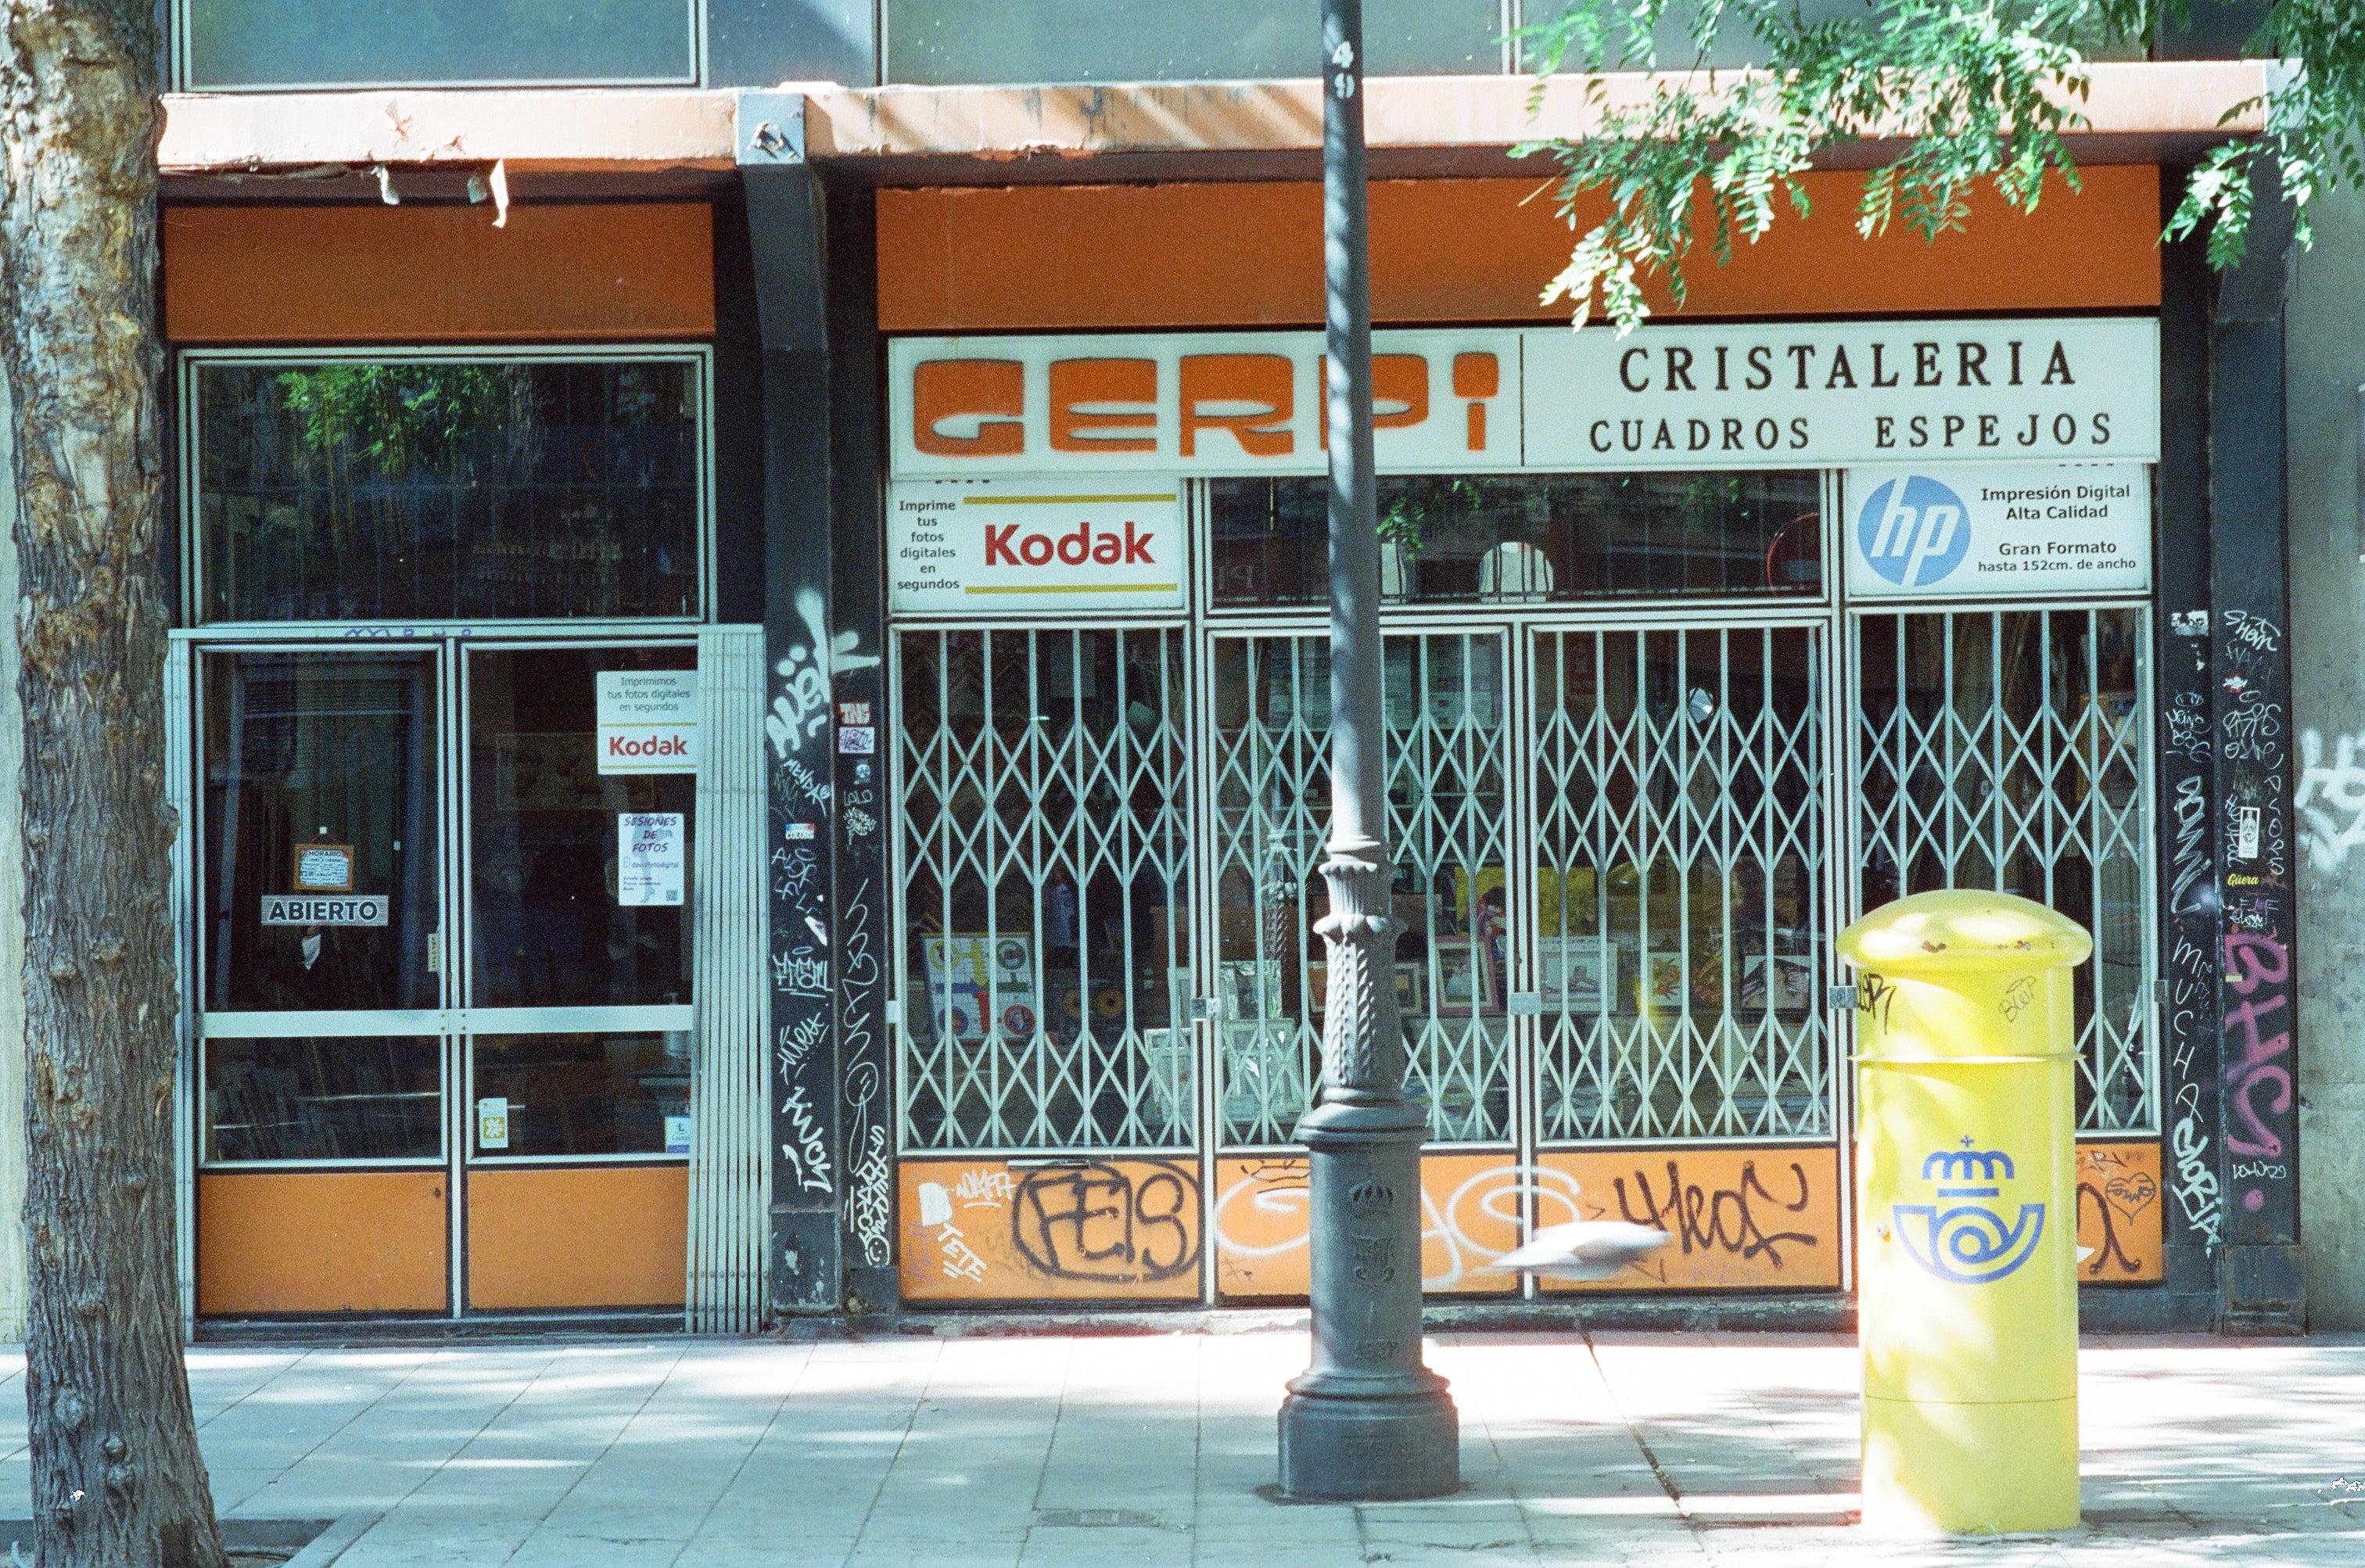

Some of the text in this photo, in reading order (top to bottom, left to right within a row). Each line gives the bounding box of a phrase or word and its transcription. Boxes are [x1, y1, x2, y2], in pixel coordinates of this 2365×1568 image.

[1619, 341, 2076, 393] CRISTALERIA
[1590, 418, 1810, 453] CUADROS
[1875, 412, 2112, 449] ESPEJOS
[1980, 484, 2130, 504] Impresión Digital
[899, 499, 956, 513] Imprime
[2006, 504, 2108, 520] Alta Calidad
[917, 516, 938, 526] tus
[911, 531, 945, 542] fotos
[1870, 476, 1961, 587] hp
[985, 522, 1156, 566] Kodak
[1999, 541, 2117, 555] Gran Formato
[900, 547, 956, 560] digitales
[920, 565, 936, 573] en
[1978, 558, 2137, 572] hasta 152cm. de ancho
[897, 579, 960, 591] segundos
[621, 677, 677, 687] Imprimimos
[625, 690, 648, 698] fotos
[651, 689, 691, 700] digitales
[634, 702, 679, 712] segundos
[610, 735, 687, 756] Kodak
[624, 816, 677, 826] SESIONES
[643, 830, 657, 839] DE
[632, 843, 669, 852] FOTOS
[269, 901, 378, 920] ABIERTO
